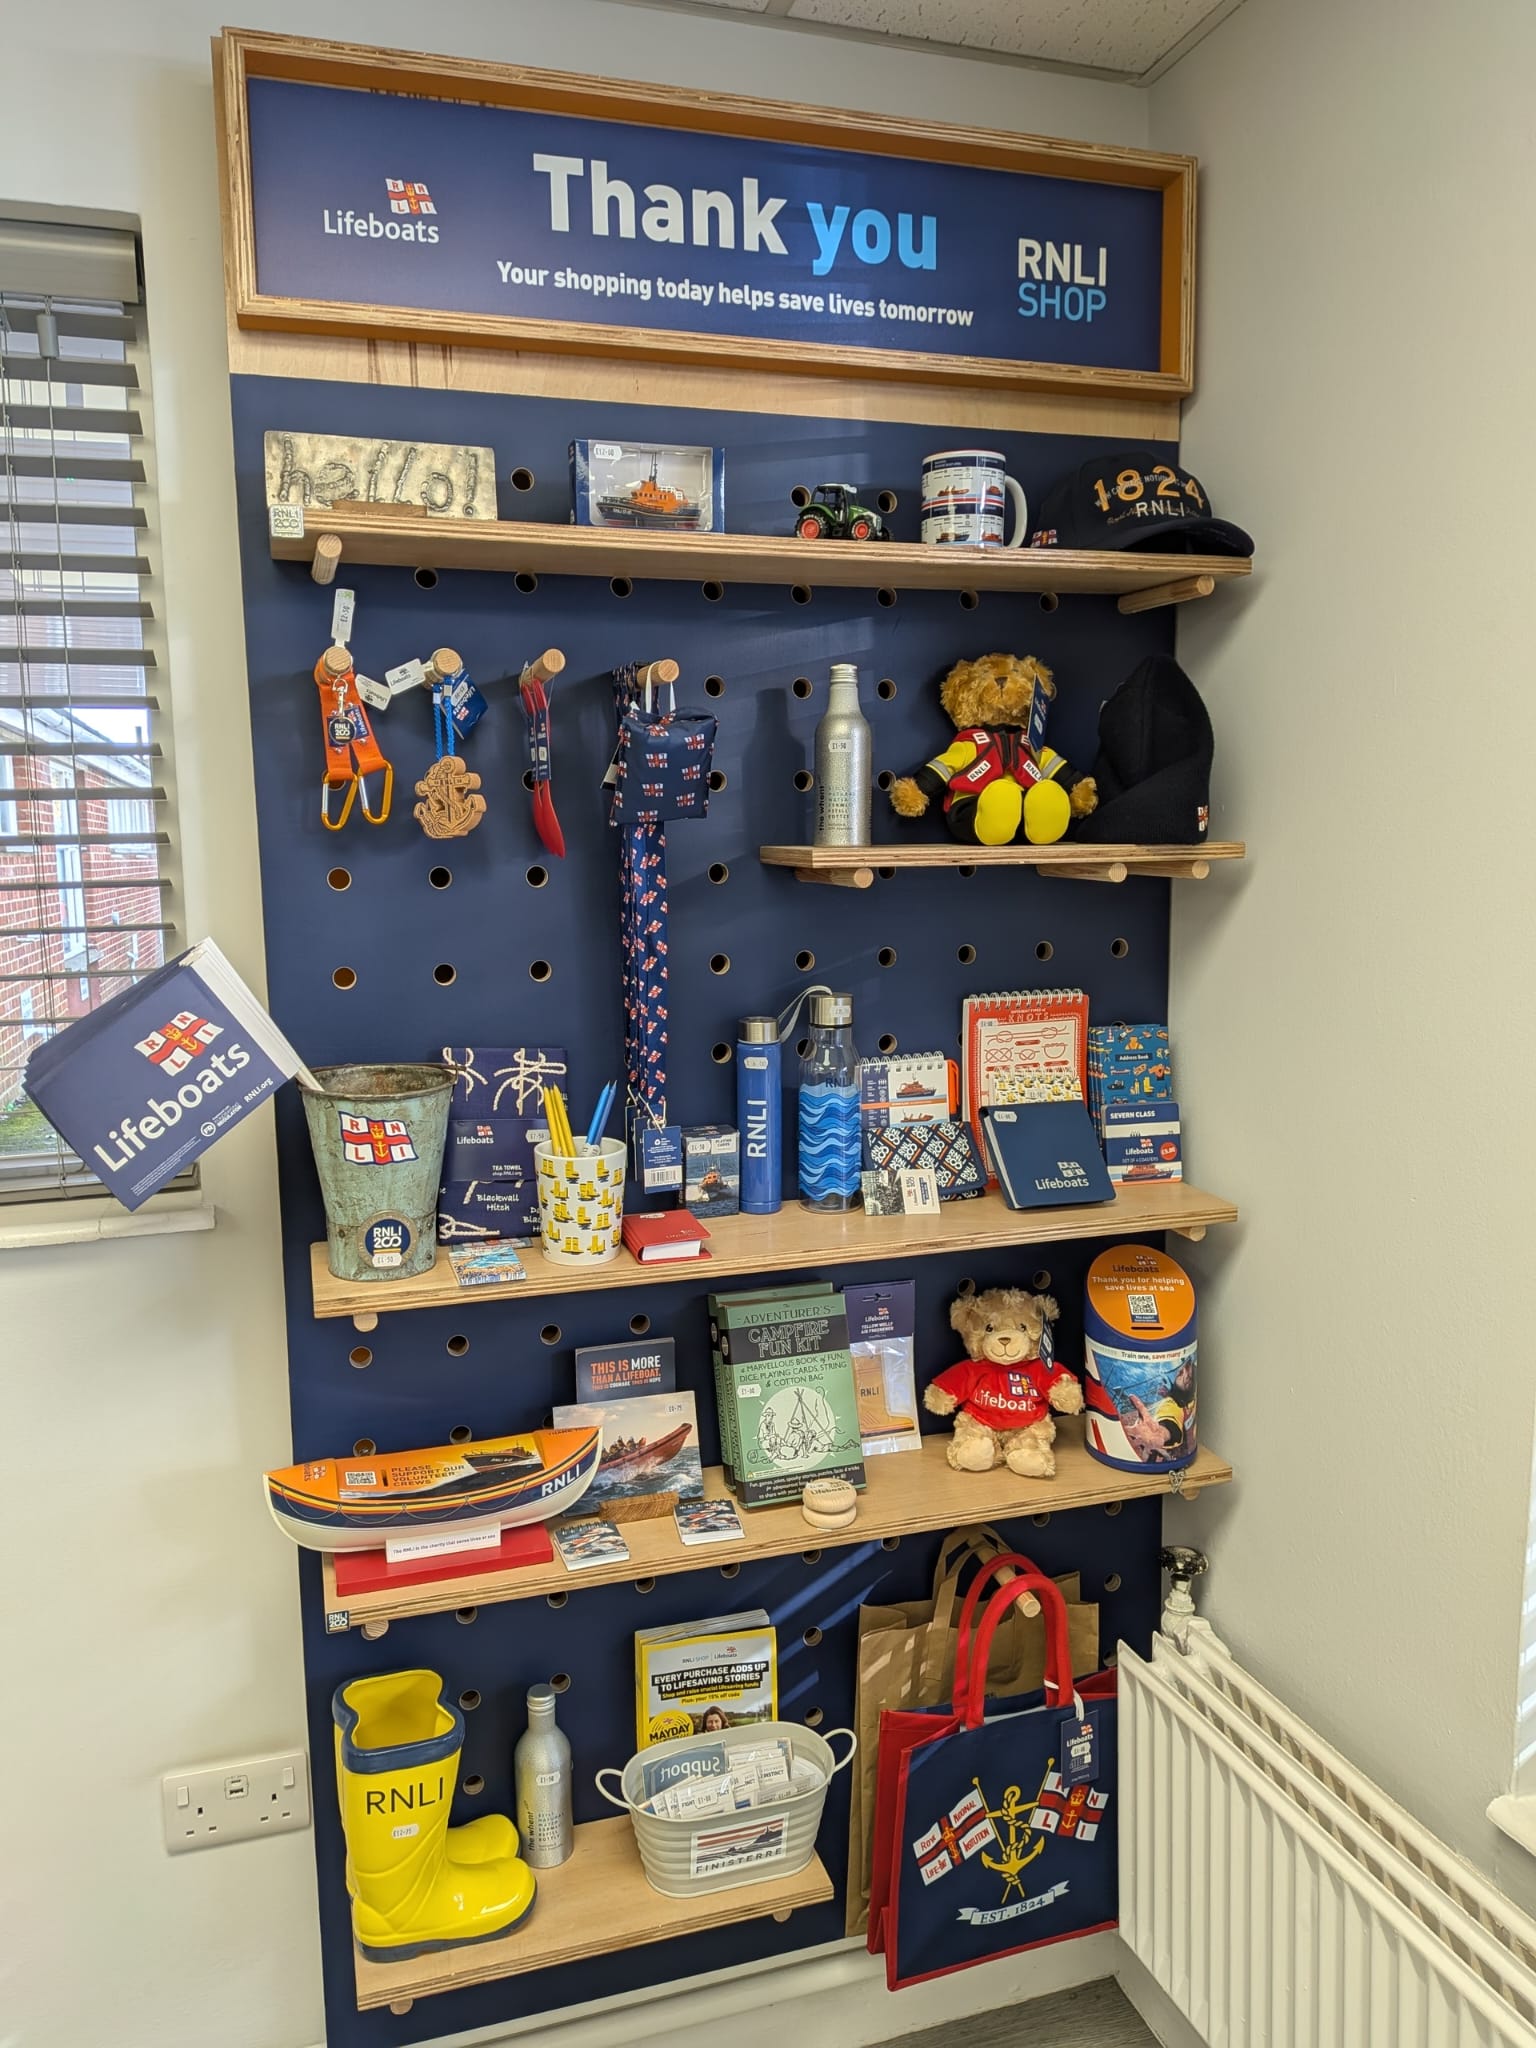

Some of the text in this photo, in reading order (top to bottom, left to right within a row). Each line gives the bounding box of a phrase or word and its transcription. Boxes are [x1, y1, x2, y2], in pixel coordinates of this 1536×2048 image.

[532, 152, 938, 276] Thank you
[323, 210, 439, 243] Lifeboats
[1018, 238, 1107, 287] RNLI
[498, 261, 974, 327] Your shopping today helps save lives tomorrow
[1018, 282, 1106, 323] SHOP
[1094, 465, 1204, 511] 1824
[274, 508, 299, 518] RNLI
[1136, 500, 1184, 517] RNLI
[969, 763, 988, 779] RNLI
[1026, 763, 1042, 780] RNLI
[1008, 1012, 1049, 1022] KNOTS
[244, 1078, 273, 1103] RNLI.org
[94, 1043, 250, 1172] Lifeboats
[1110, 1111, 1135, 1119] SEVERN
[747, 1100, 767, 1158] RNLI
[456, 1136, 494, 1144] Lifeboats
[1125, 1147, 1154, 1155] Lifeboats
[1035, 1178, 1090, 1190] Lifeboats
[476, 1194, 519, 1202] Blackwall
[373, 1226, 402, 1237] RNLI
[374, 1237, 402, 1248] 200
[1112, 1264, 1160, 1273] Lifeboats
[1091, 1276, 1185, 1286] Thank you for helping
[1126, 1283, 1147, 1291] lives
[743, 1305, 831, 1324] ADVENTURER'S
[748, 1320, 830, 1343] CAMPFIRE
[758, 1335, 821, 1357] FUN KIT
[591, 1356, 661, 1375] THIS IS MORE
[747, 1356, 818, 1371] MARVELLOUS BOOK
[760, 1362, 847, 1379] PLAYING STRING
[591, 1368, 661, 1384] THAN A LIFEBOAT.
[774, 1376, 806, 1386] COTTON
[860, 1387, 879, 1397] RNLI
[974, 1390, 1037, 1412] Lifeboats
[391, 1464, 432, 1473] PLEASE
[391, 1468, 442, 1478] SUPPORT
[392, 1472, 455, 1482] VOLUNTEER
[540, 1464, 582, 1497] RNLI
[429, 1542, 445, 1550] charity
[329, 1612, 348, 1620] RNLI
[714, 1652, 737, 1660] Lifeboats
[654, 1663, 767, 1685] EVERY PURCHASE ADDS UP
[661, 1672, 760, 1692] TO LIFESAVING STORIES
[649, 1723, 690, 1742] MAYDAY
[1067, 1734, 1093, 1747] Lifeboats
[365, 1776, 445, 1816] RNLI
[696, 1847, 783, 1873] FINISTERRE
[980, 1898, 1046, 1925] EST. 1824
